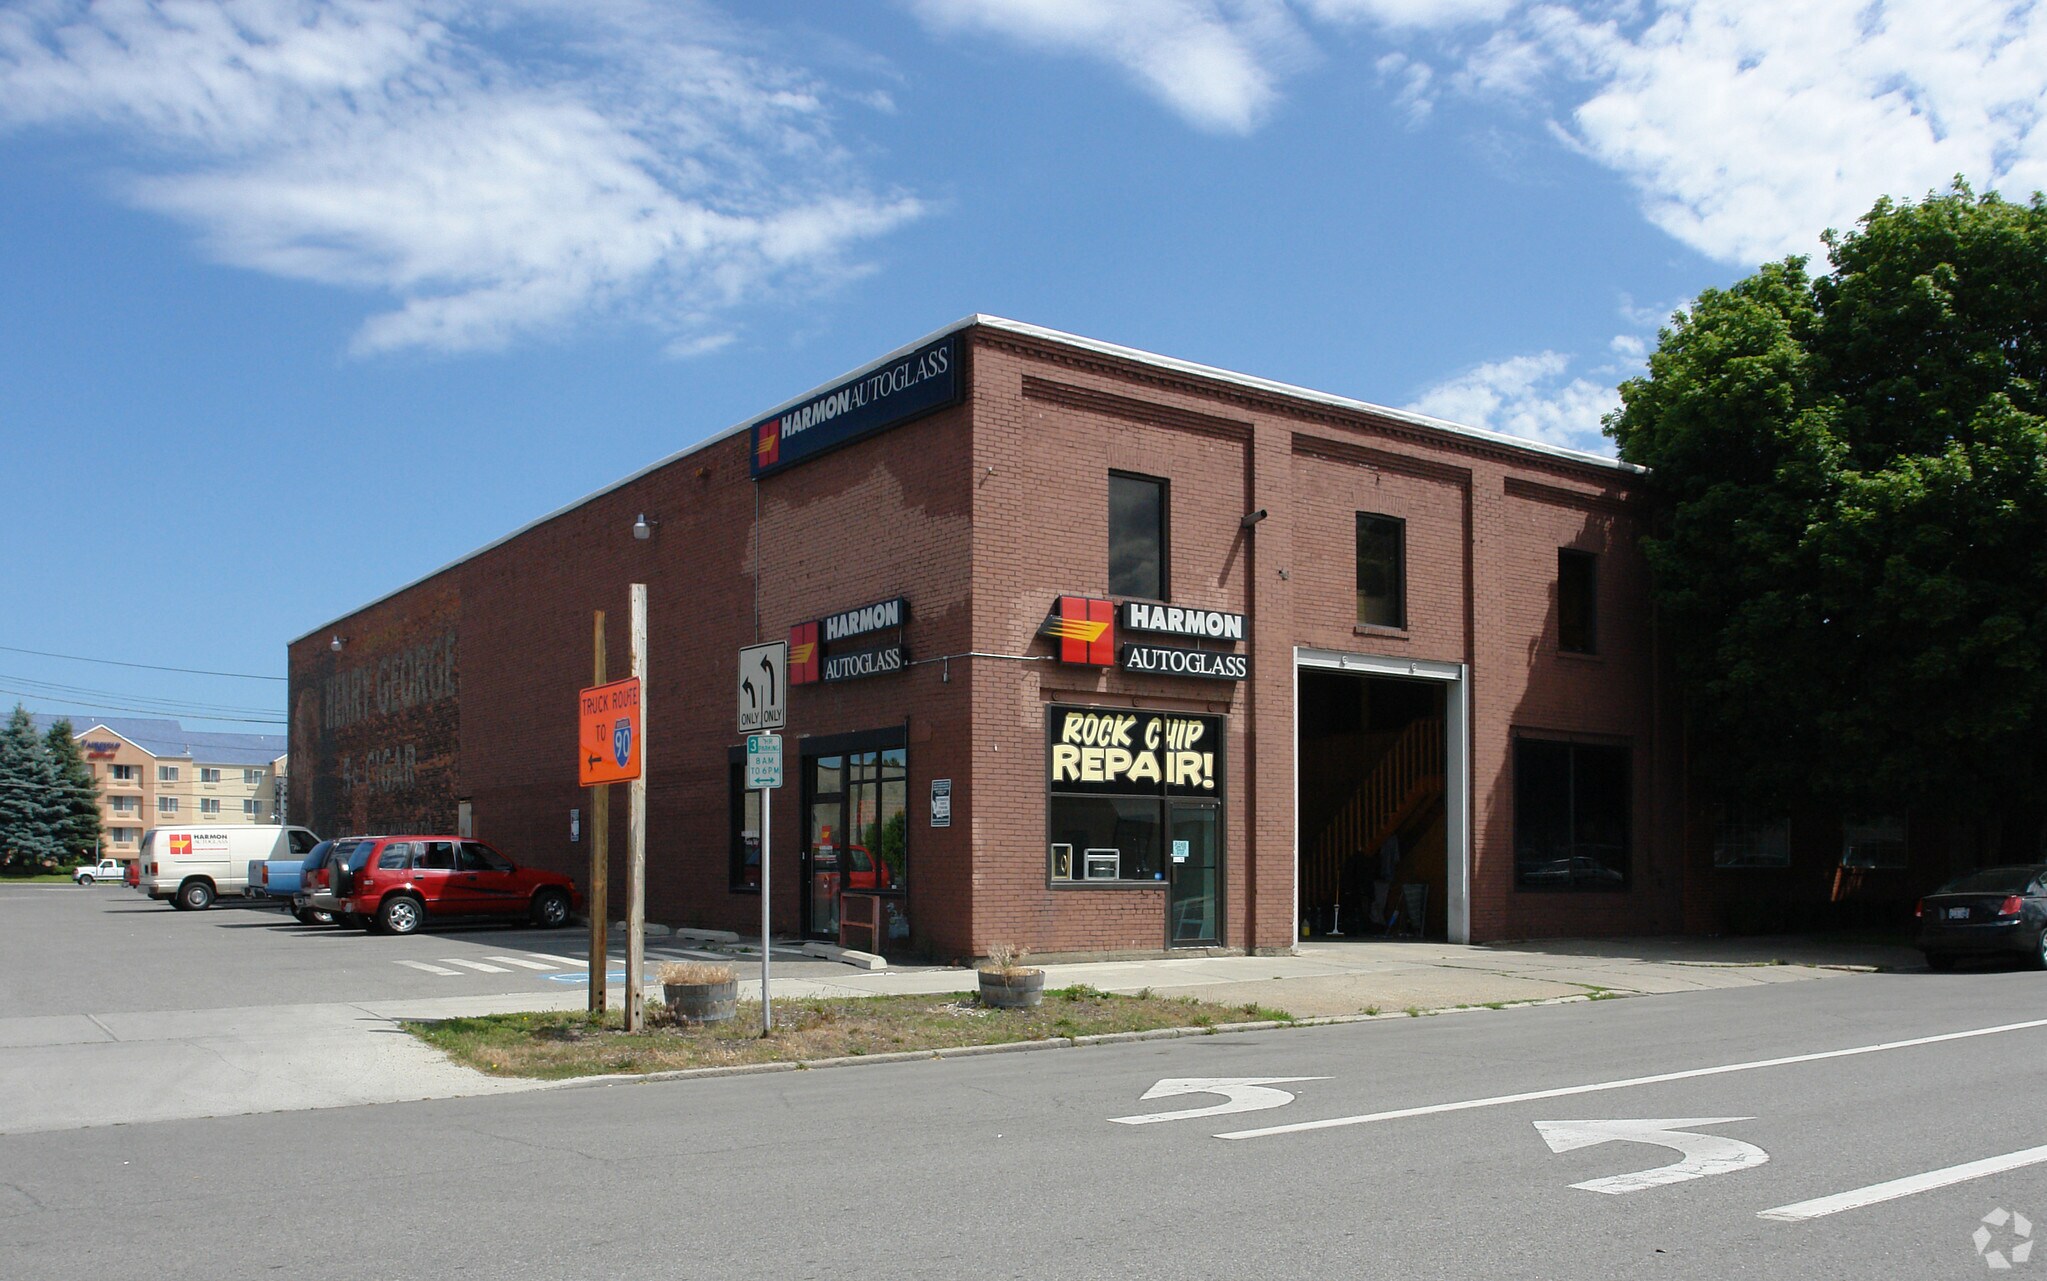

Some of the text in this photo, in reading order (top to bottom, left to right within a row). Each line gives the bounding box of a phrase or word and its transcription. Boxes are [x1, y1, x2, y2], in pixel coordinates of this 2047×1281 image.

[827, 600, 898, 640] HARMON
[1130, 603, 1242, 638] HARMON
[825, 648, 900, 679] AUTOGLASS
[1127, 647, 1246, 677] AUTOGLASS
[582, 687, 637, 716] TRUCK ROUTE
[764, 708, 782, 723] ONLY
[741, 711, 759, 725] ONLY
[1062, 712, 1204, 750] ROCK CHIP
[596, 724, 606, 742] TO
[615, 729, 630, 758] 90
[750, 739, 757, 751] 3
[751, 767, 760, 775] TO
[1053, 744, 1215, 789] REPAIR!
